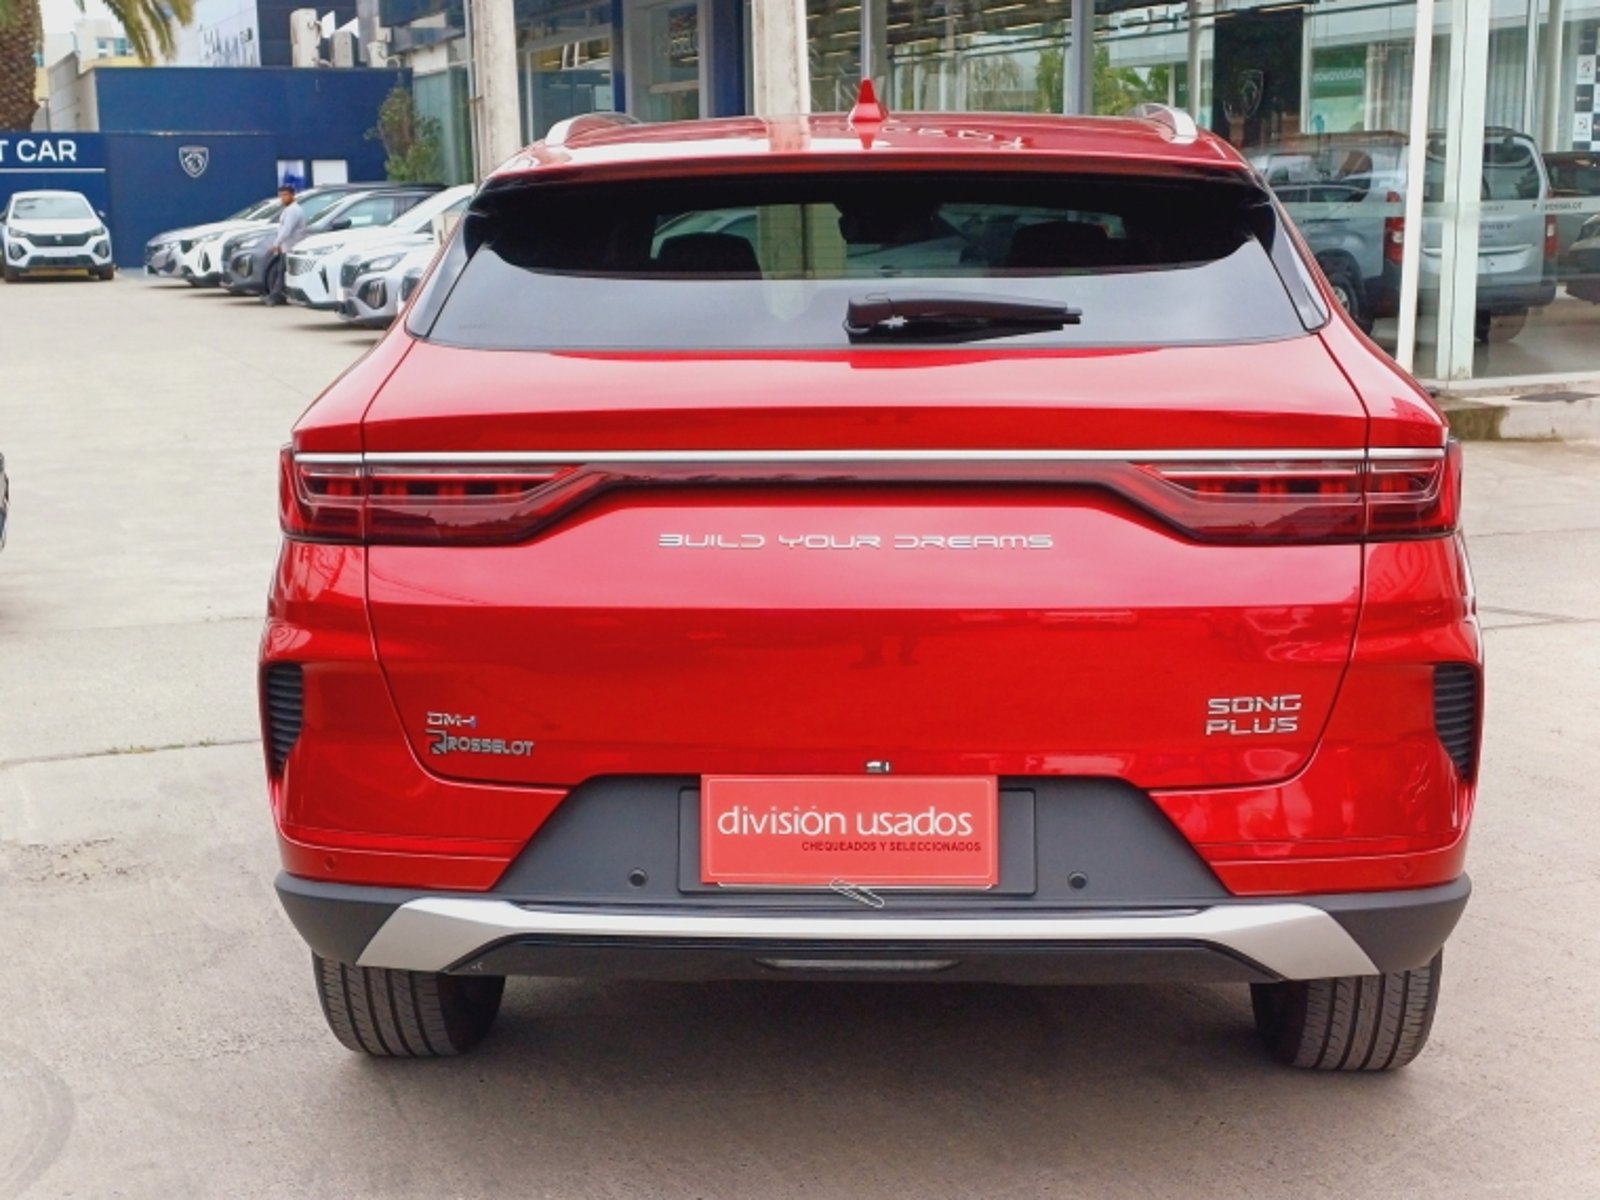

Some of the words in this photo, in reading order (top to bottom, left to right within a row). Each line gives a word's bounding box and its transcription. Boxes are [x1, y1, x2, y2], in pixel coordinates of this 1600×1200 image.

[16, 139, 77, 162] CAR
[658, 533, 765, 549] BUILD
[778, 533, 881, 549] YOUR
[894, 534, 1054, 550] DREAMS
[1207, 694, 1302, 715] SONG
[1205, 716, 1298, 736] PLUS
[717, 805, 847, 836] división
[856, 806, 974, 837] usados
[801, 841, 878, 852] CHEQUEADOS
[880, 841, 888, 851] Y
[889, 841, 982, 852] SELECCIONADOS
